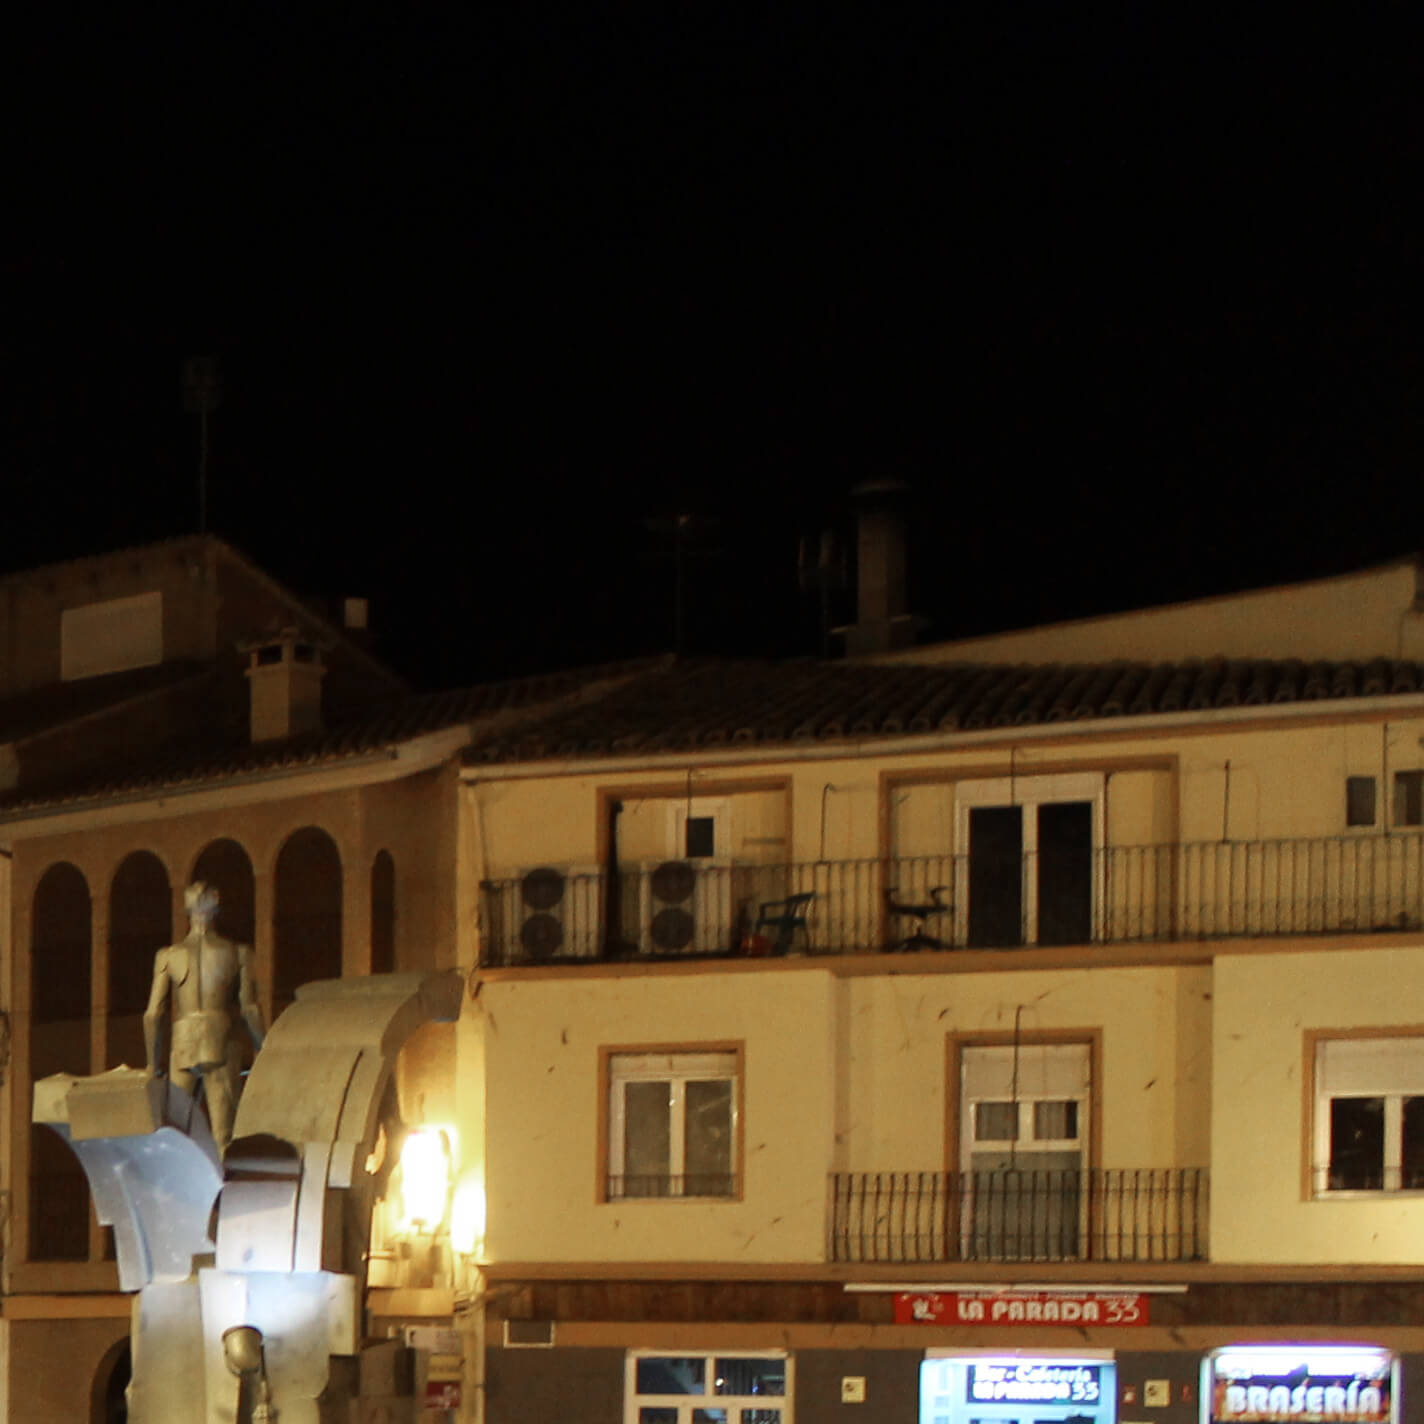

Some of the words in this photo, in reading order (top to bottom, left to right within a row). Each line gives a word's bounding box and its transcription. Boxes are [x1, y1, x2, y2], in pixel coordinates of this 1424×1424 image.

[957, 1299, 985, 1320] LA
[991, 1299, 1100, 1322] PARADA
[1103, 1298, 1141, 1324] 33
[1071, 1380, 1099, 1401] 33
[1226, 1380, 1382, 1415] BRASERÍA
